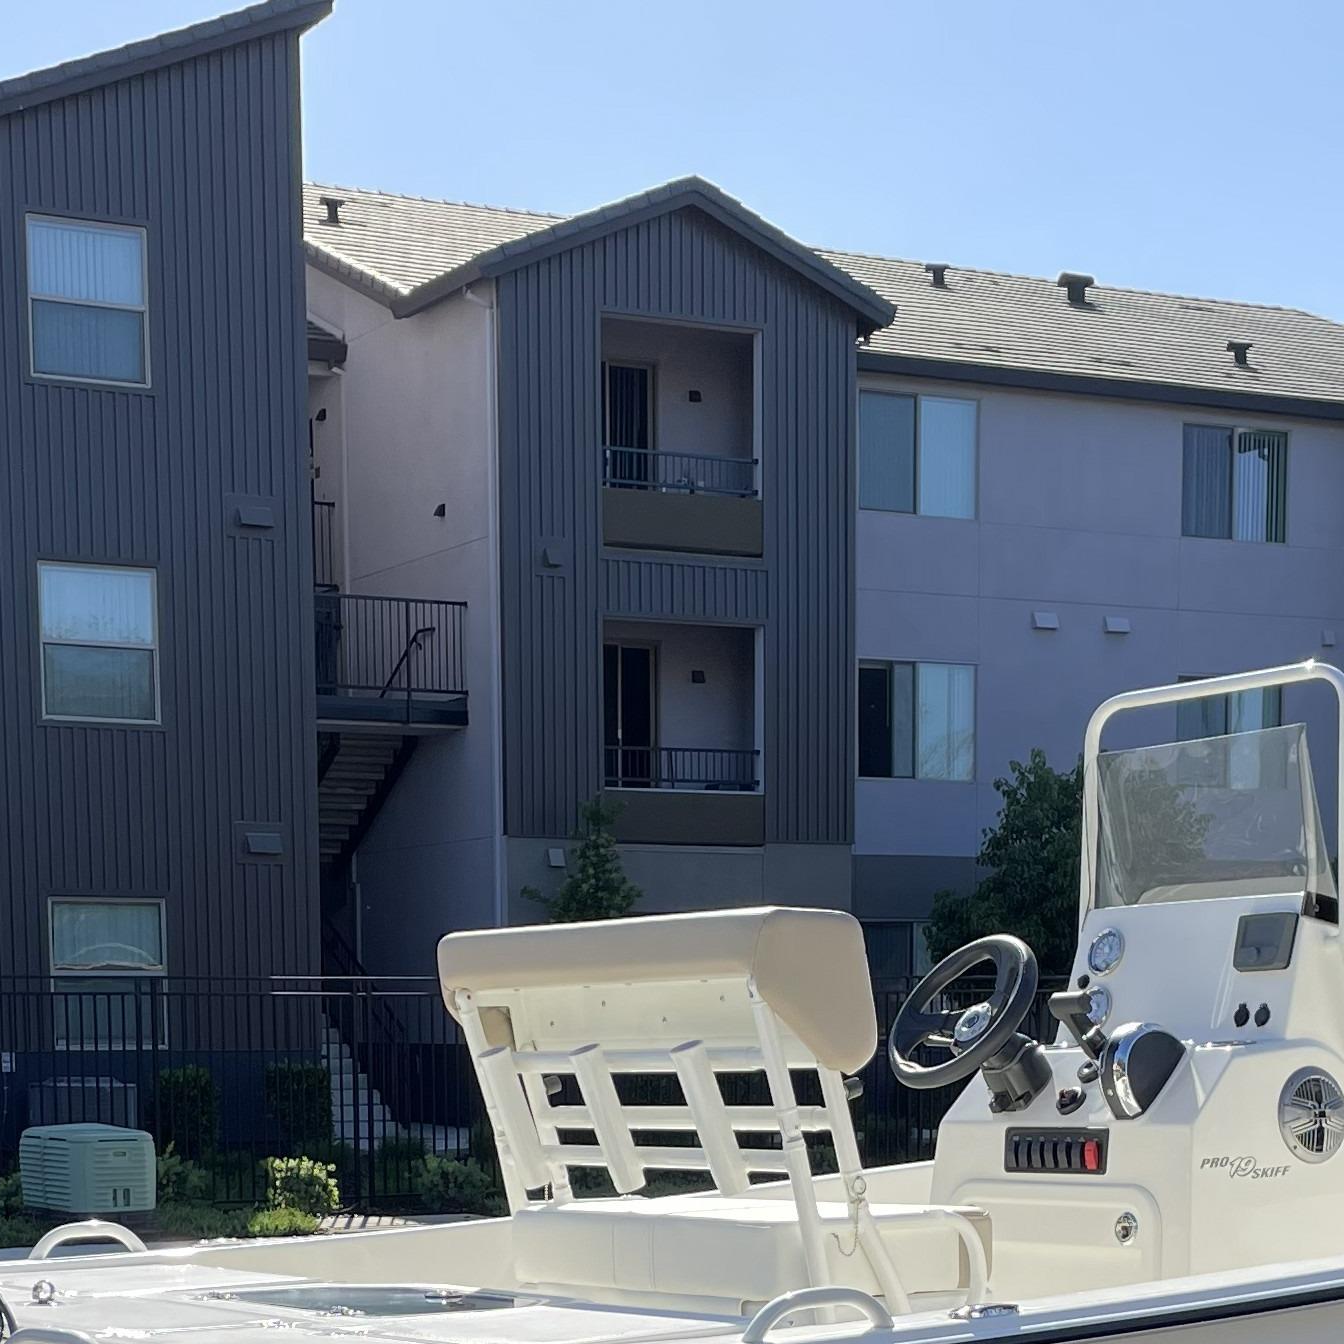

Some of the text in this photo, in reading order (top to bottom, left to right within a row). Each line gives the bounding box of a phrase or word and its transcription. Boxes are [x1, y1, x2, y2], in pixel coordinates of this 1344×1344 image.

[1200, 1156, 1292, 1179] PRO 19 SKIFF
